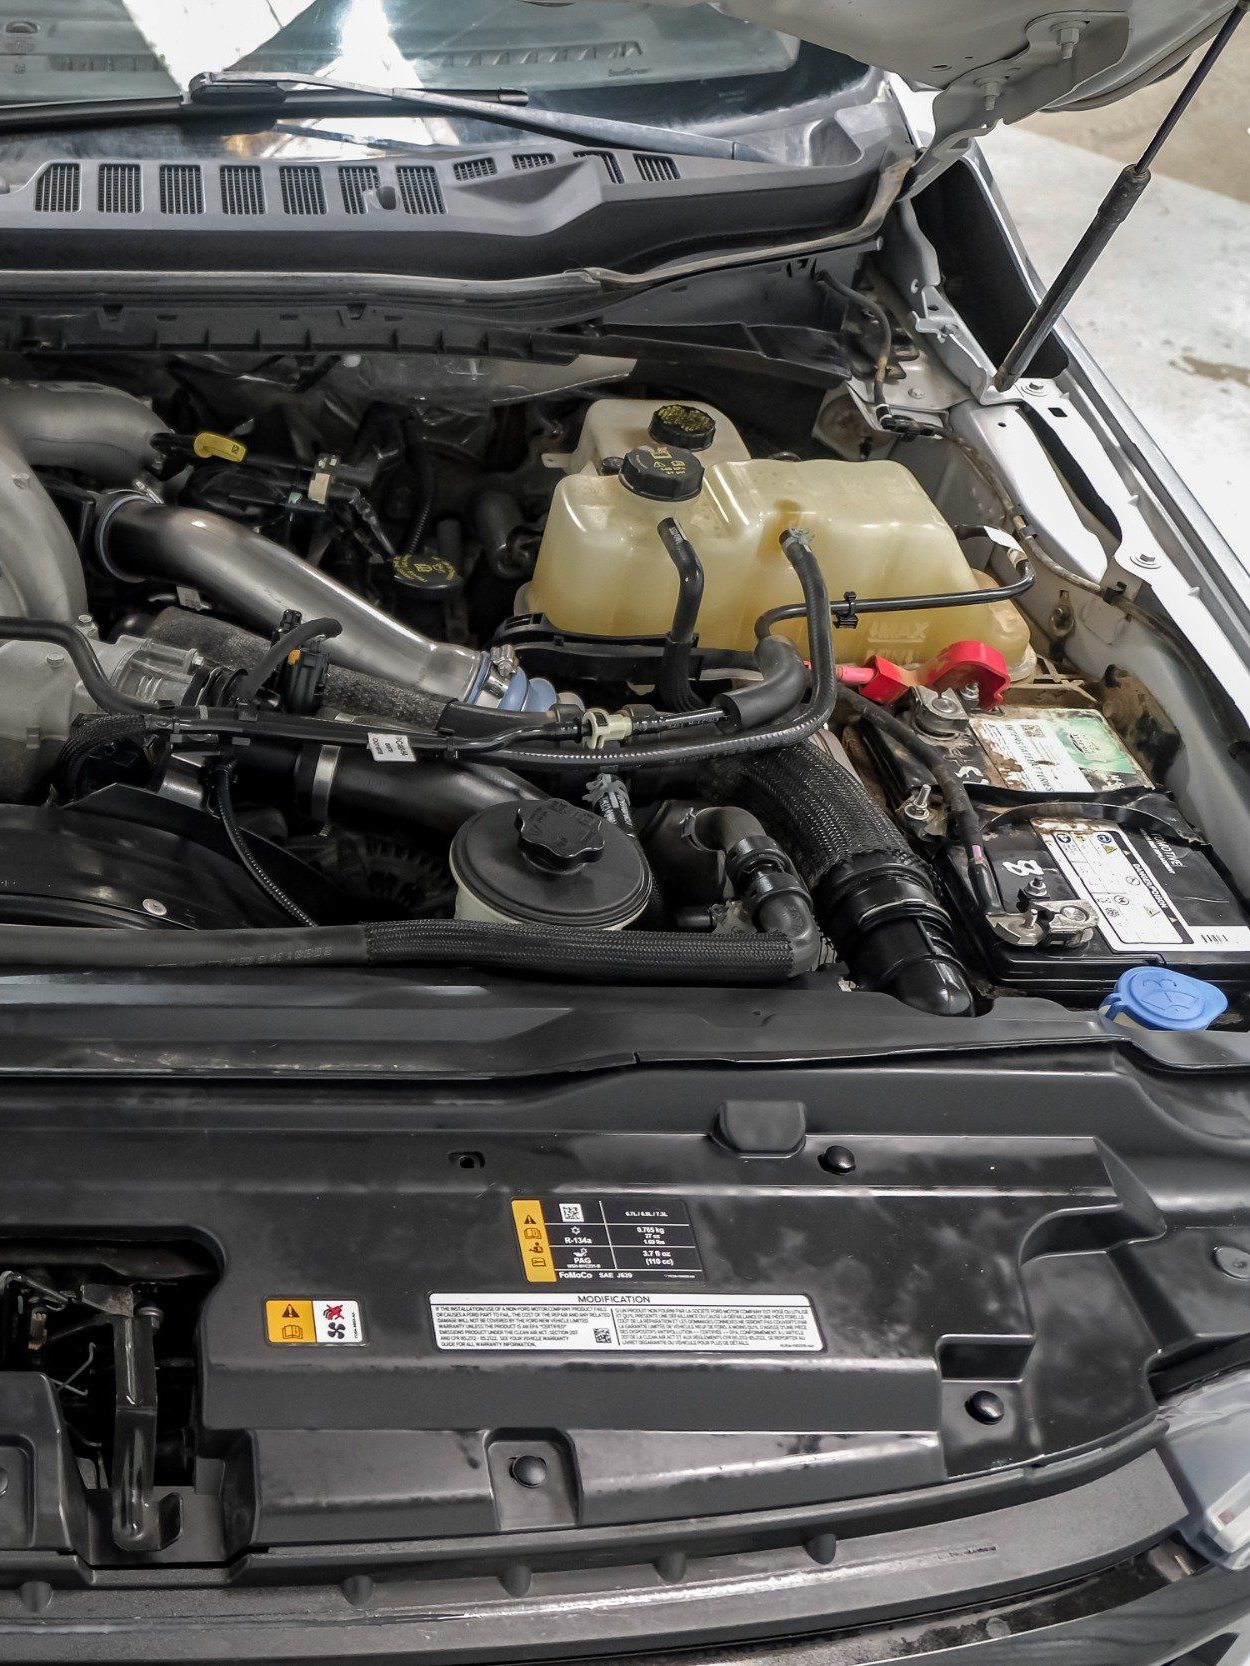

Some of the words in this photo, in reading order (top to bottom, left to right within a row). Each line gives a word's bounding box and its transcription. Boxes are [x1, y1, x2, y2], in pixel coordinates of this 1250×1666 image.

[655, 1227, 665, 1235] kg
[564, 1237, 593, 1245] R-134a
[645, 1258, 661, 1266] (110
[662, 1258, 674, 1266] cc)
[559, 1271, 593, 1279] FoMoCo
[577, 1295, 651, 1303] MODIFICATION
